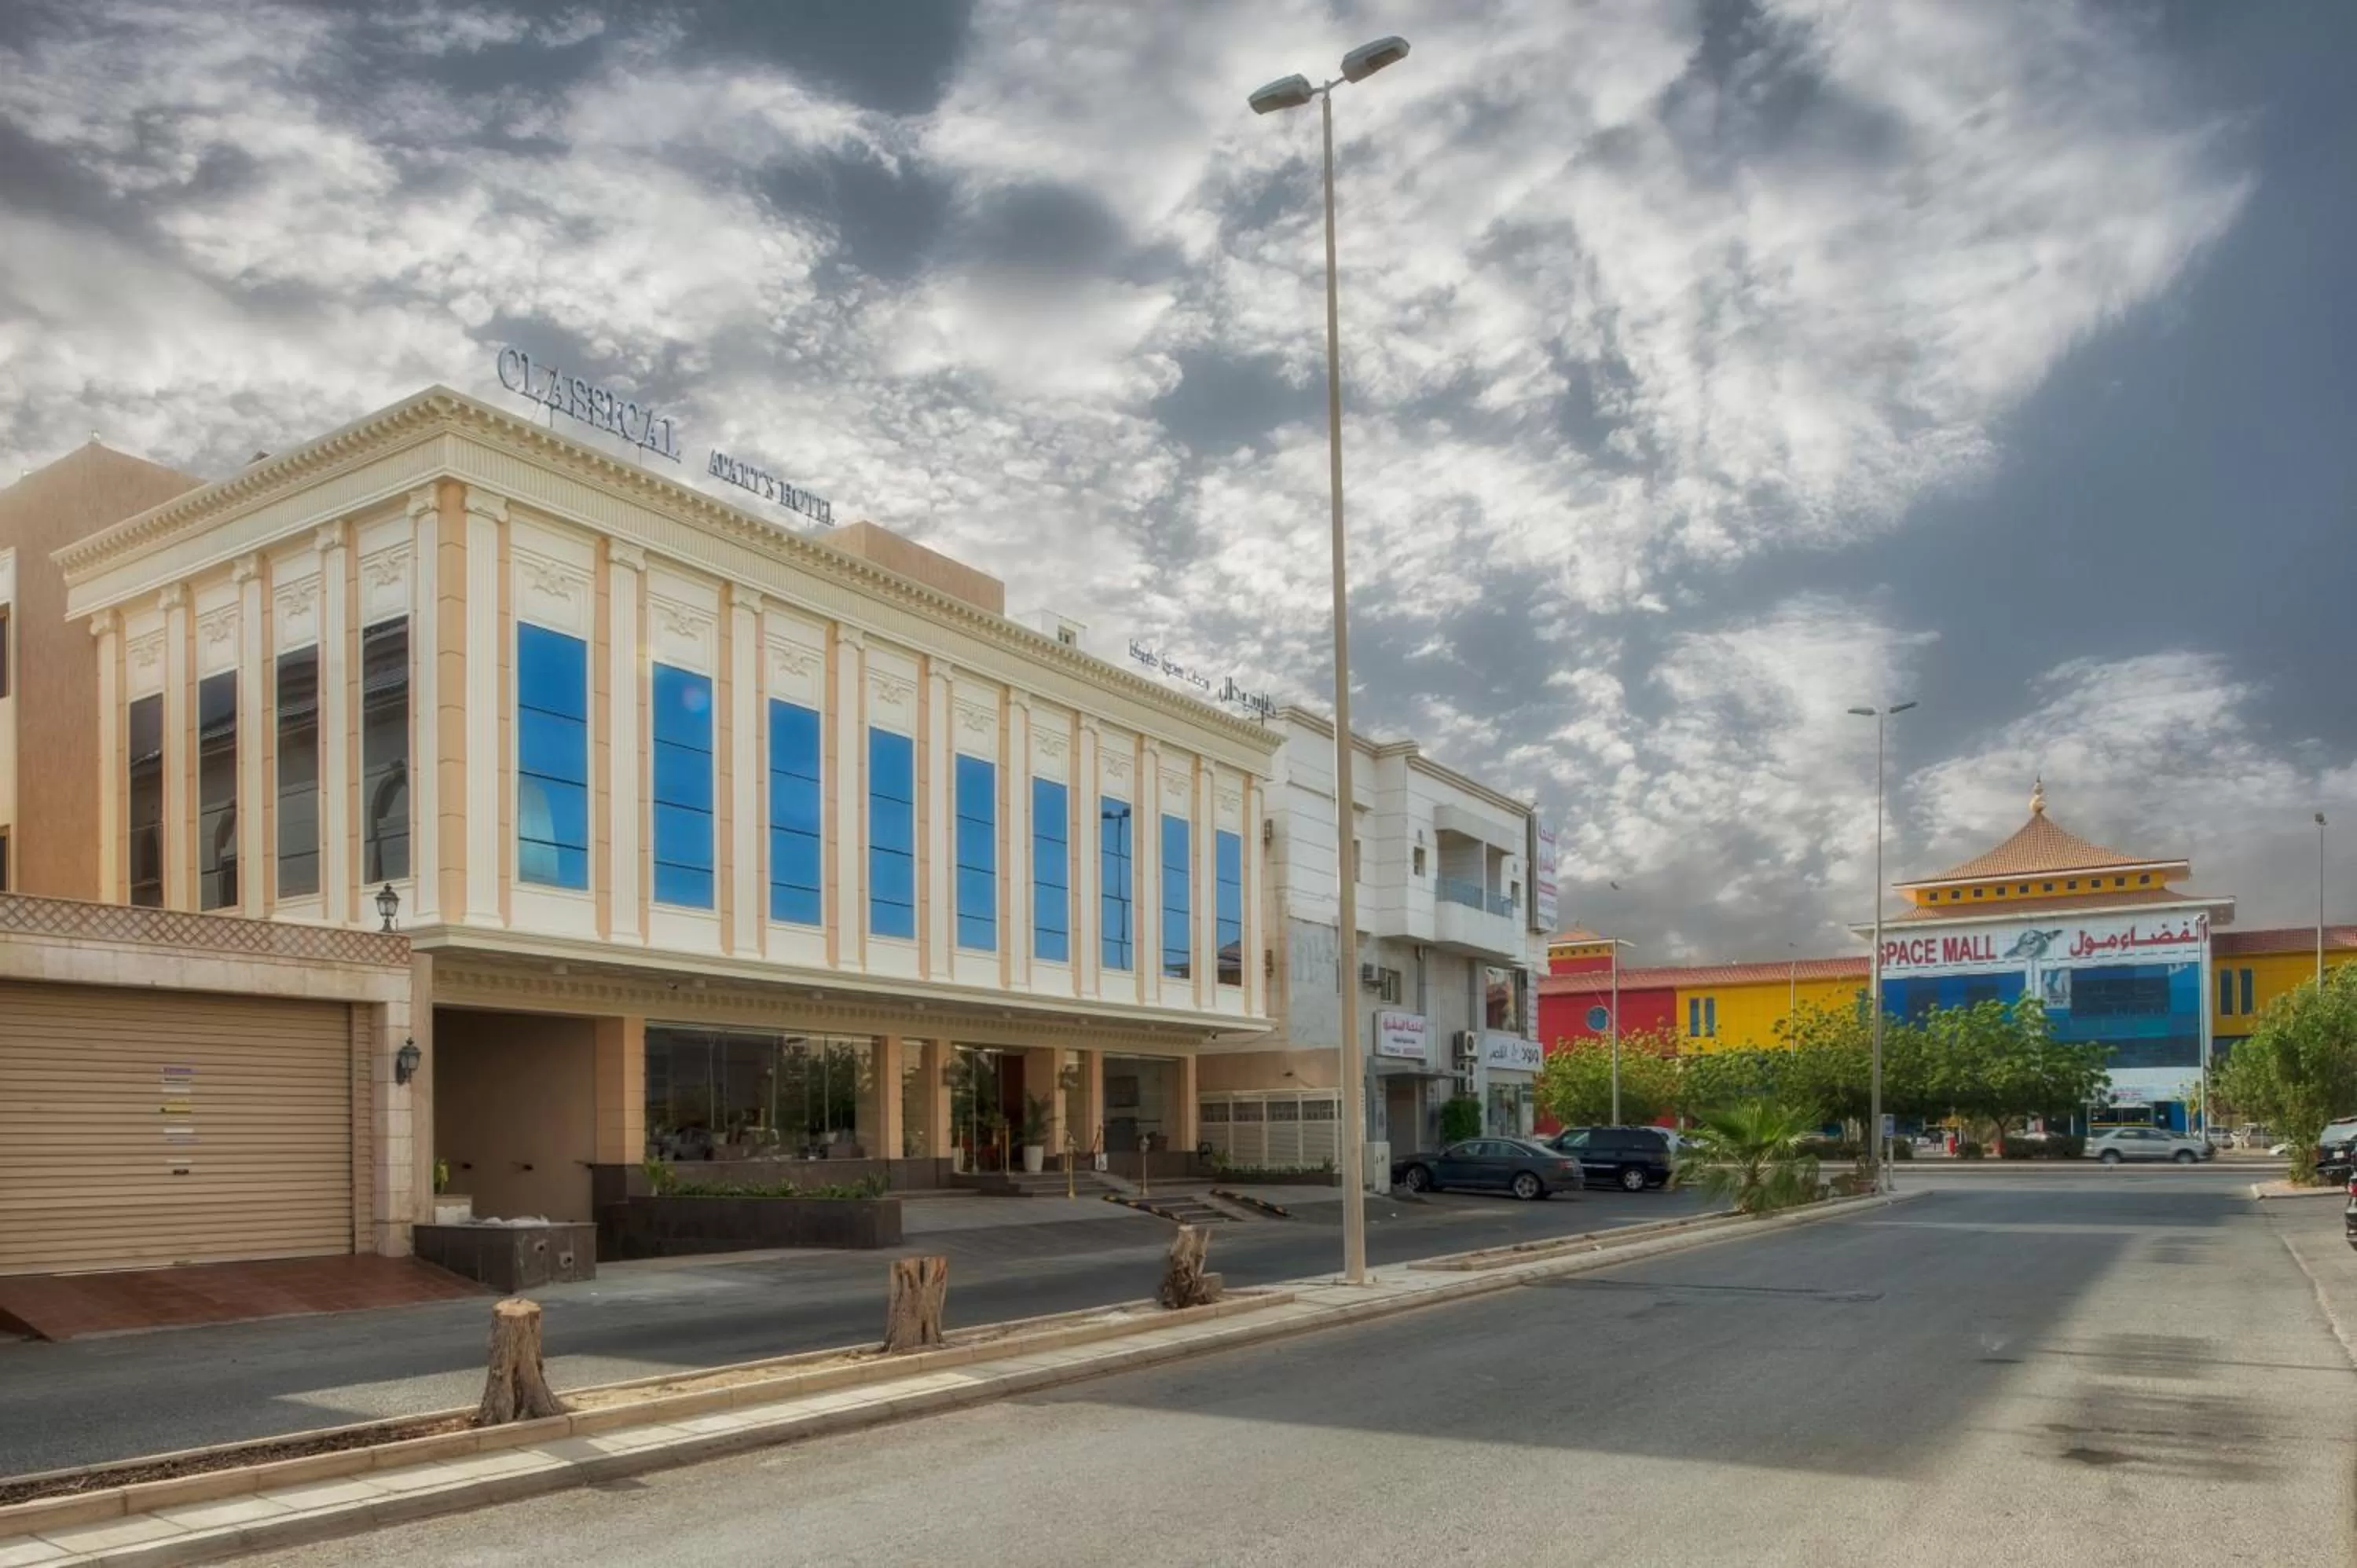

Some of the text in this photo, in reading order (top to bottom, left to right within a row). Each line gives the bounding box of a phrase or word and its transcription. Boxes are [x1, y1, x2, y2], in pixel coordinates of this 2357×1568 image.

[497, 346, 681, 463] CLASSICAL
[779, 480, 836, 526] HOTEL
[1942, 935, 1997, 962] MALL
[2069, 930, 2119, 956] مول
